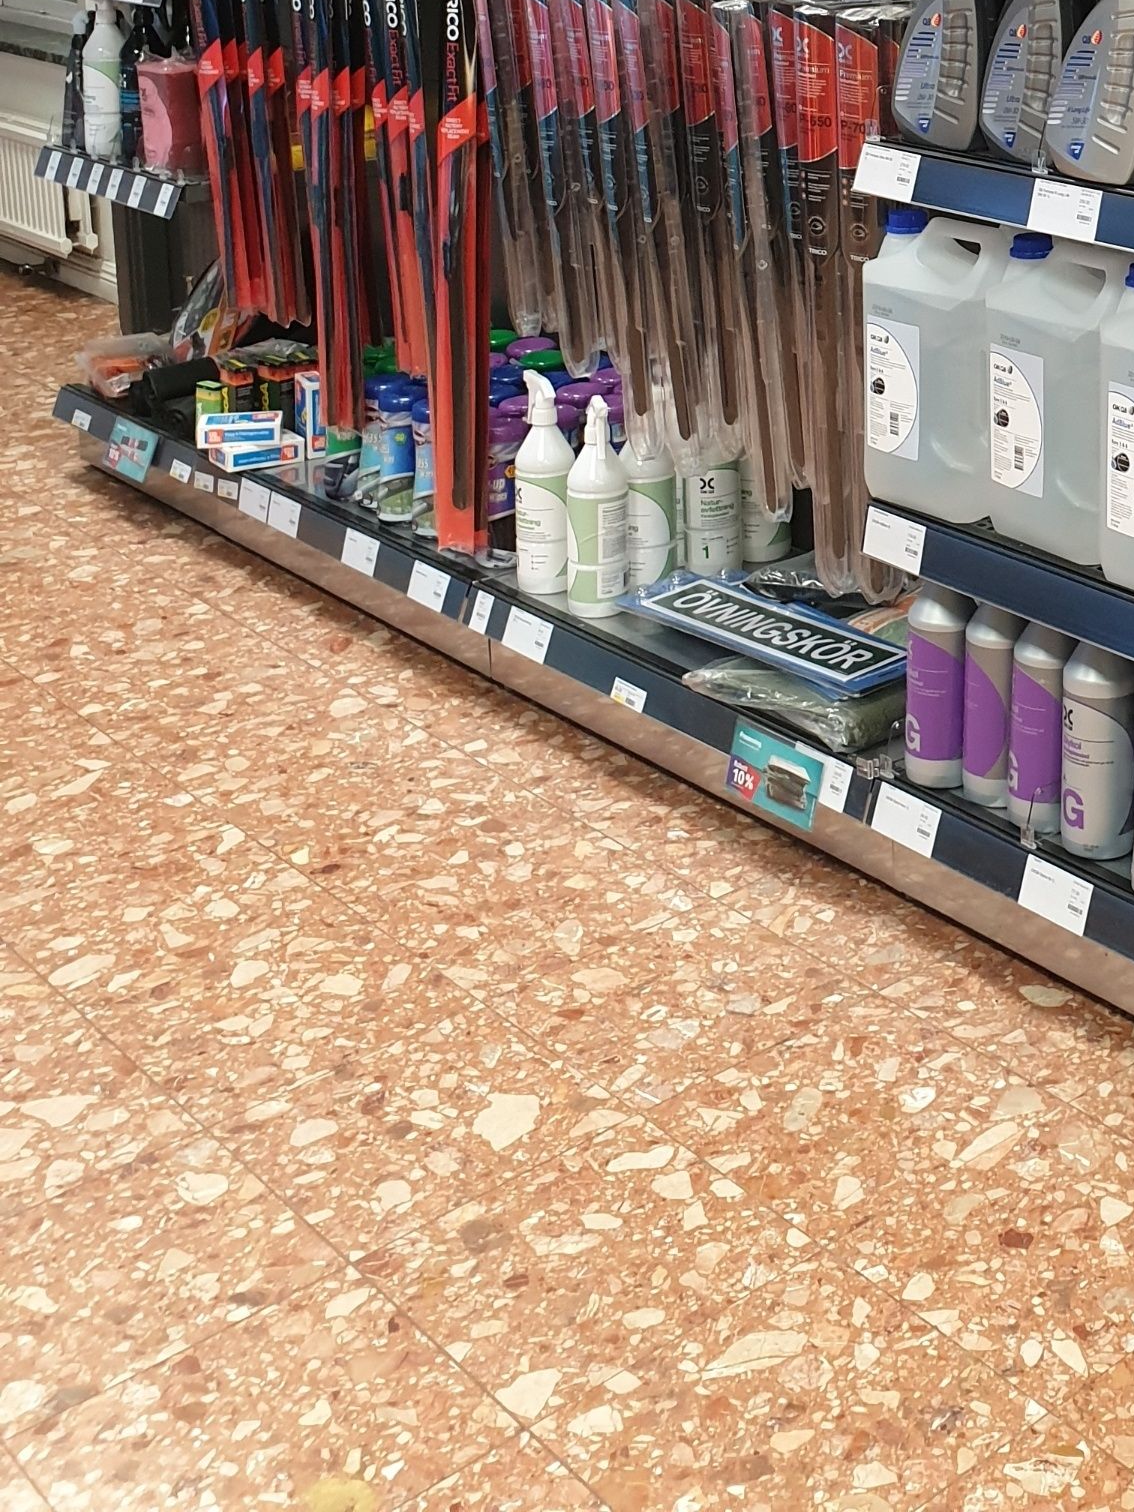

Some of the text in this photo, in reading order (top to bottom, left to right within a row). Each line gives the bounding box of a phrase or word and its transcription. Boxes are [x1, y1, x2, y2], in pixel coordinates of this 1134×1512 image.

[840, 118, 868, 135] P-70
[701, 544, 710, 560] 1
[673, 588, 874, 670] ÖVNINGSKÖR
[732, 767, 756, 791] 10%
[1062, 788, 1086, 831] G
